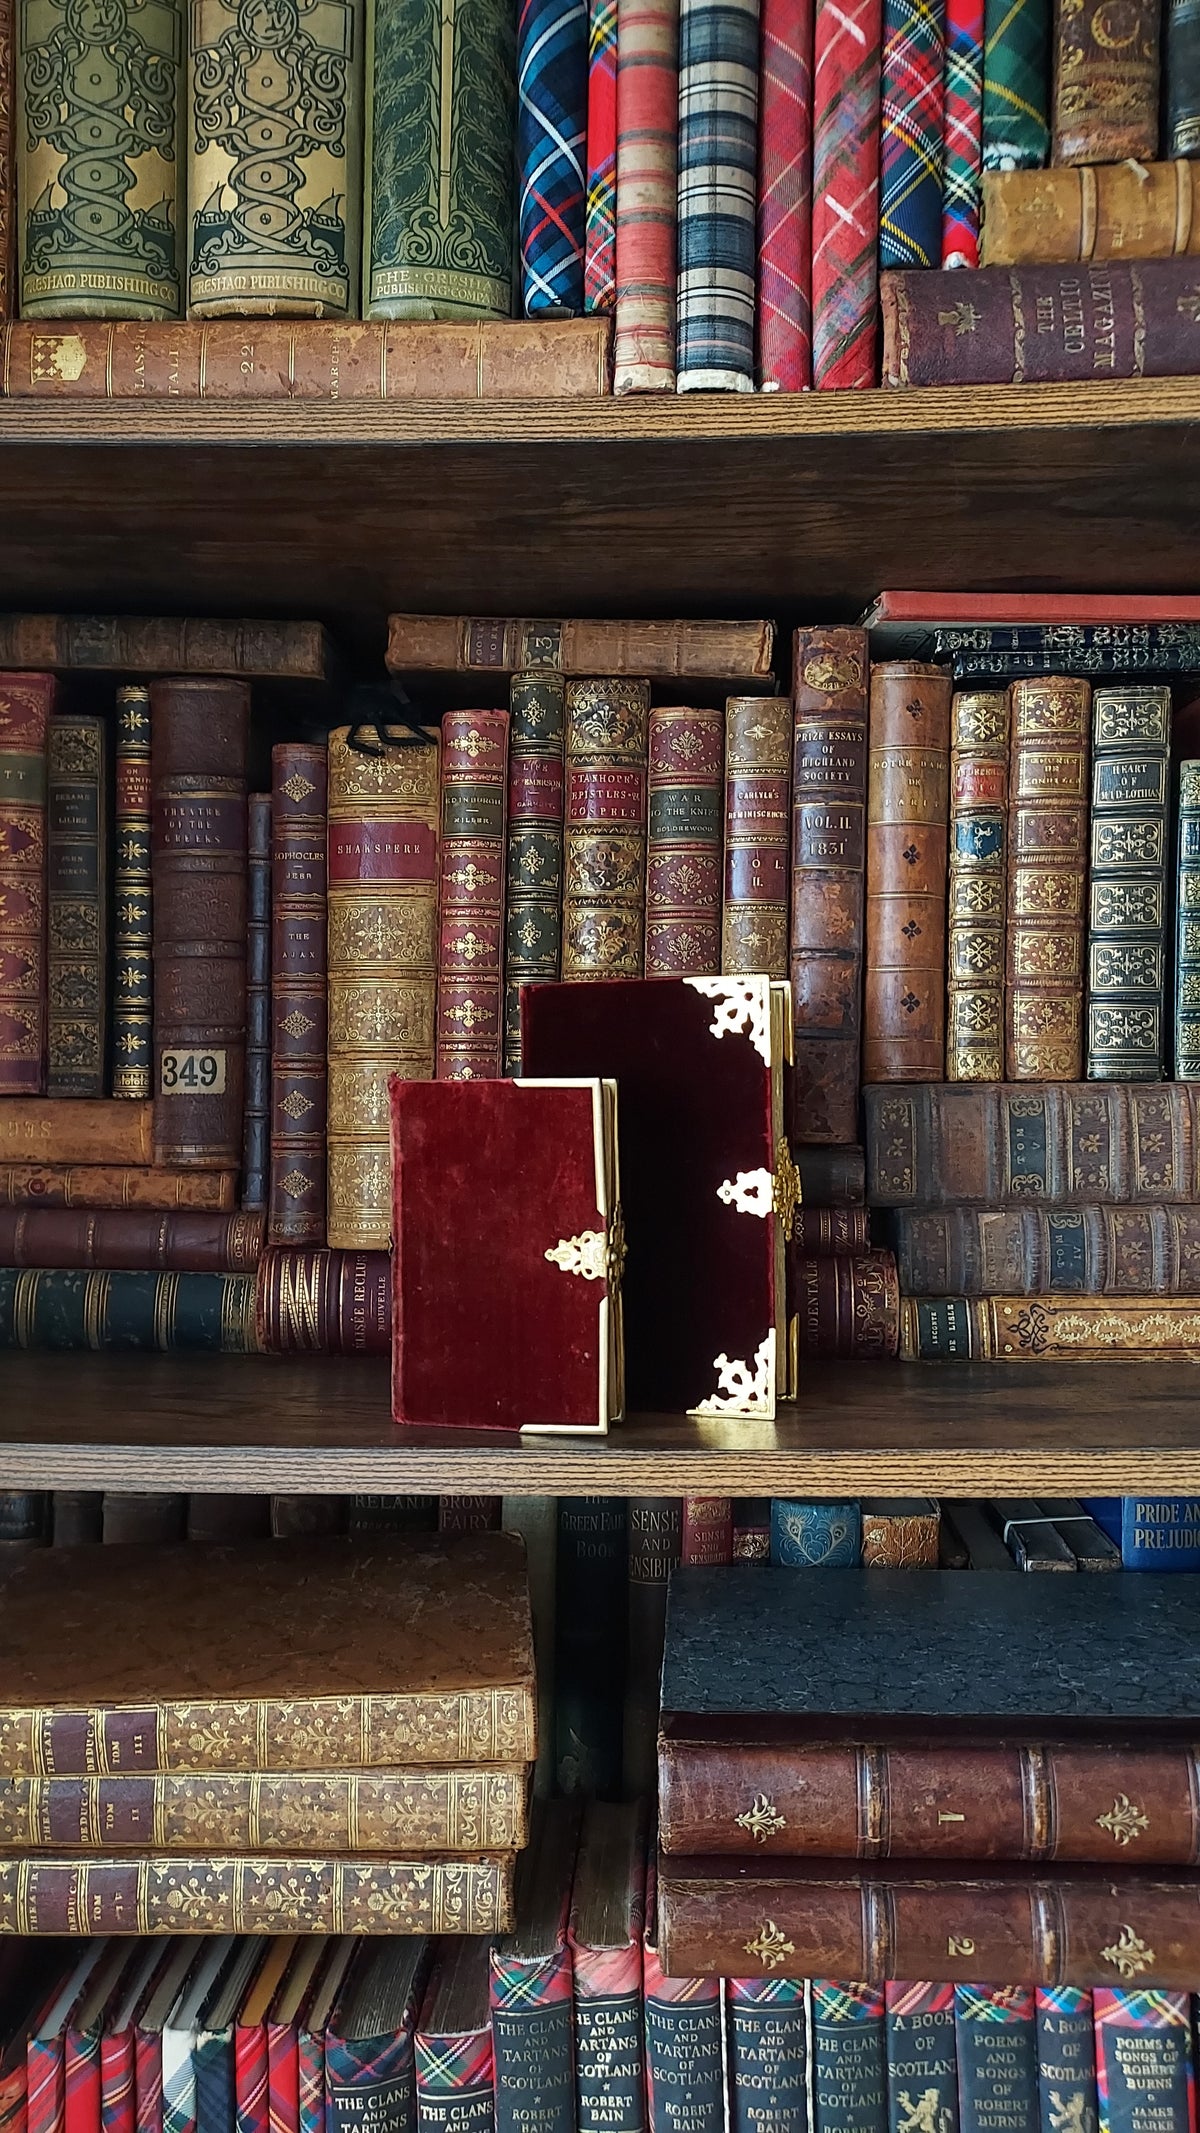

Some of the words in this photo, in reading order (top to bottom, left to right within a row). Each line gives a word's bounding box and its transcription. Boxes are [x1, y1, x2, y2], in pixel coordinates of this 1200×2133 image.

[376, 270, 410, 285] THE
[80, 273, 158, 296] PUBLISHING
[160, 286, 176, 301] CO
[251, 274, 327, 292] PUBLISHING
[328, 282, 345, 300] CO
[1037, 296, 1054, 334] THE
[1060, 278, 1085, 354] CELTIC
[240, 345, 254, 375] 22
[796, 731, 824, 743] PRIZE
[829, 731, 863, 742] ESSAYS
[821, 745, 835, 755] OF
[802, 759, 855, 768] HIGHLAND
[1112, 764, 1148, 775] HEART
[804, 770, 850, 781] SOCIETY
[1121, 777, 1138, 786] OF
[668, 793, 702, 802] WAR
[571, 806, 636, 817] GOSPELS
[667, 808, 685, 816] THE
[690, 807, 720, 817] KNIFE
[164, 834, 221, 844] GREEKS
[337, 843, 421, 854] SHAKSPERE
[809, 843, 845, 856] 1831
[274, 852, 324, 862] SOPHOCLES
[282, 951, 316, 959] AJAX
[162, 1055, 218, 1088] 349
[354, 1255, 367, 1302] RECLUS
[377, 1275, 386, 1332] NOUVELLE
[947, 1304, 955, 1331] LISLE
[930, 1311, 938, 1344] LECONTE
[949, 1339, 956, 1352] DE
[1135, 1503, 1180, 1523] PRIDE
[442, 1511, 493, 1530] FAIRY
[631, 1507, 679, 1534] SENSE
[641, 1537, 671, 1551] AND
[112, 1740, 121, 1764] TOM
[105, 1803, 114, 1830] TOM
[93, 1894, 102, 1921] TOM
[948, 1936, 975, 1957] 2
[577, 2012, 591, 2026] HE
[594, 2007, 639, 2026] CLANS
[649, 2011, 675, 2031] THE
[678, 2015, 720, 2032] CLANS
[892, 2015, 906, 2031] A
[498, 2021, 526, 2036] THE
[590, 2026, 616, 2037] AND
[733, 2017, 762, 2032] THE
[1043, 2018, 1055, 2034] A
[524, 2036, 549, 2047] AND
[577, 2035, 638, 2052] ARTANS
[673, 2033, 699, 2043] AND
[758, 2036, 785, 2046] AND
[915, 2036, 936, 2051] OF
[974, 2035, 1027, 2048] POEMS
[1115, 2037, 1163, 2051] POEMS
[1165, 2038, 1176, 2050] &
[502, 2044, 569, 2063] TARTANS
[653, 2040, 720, 2059] TARTANS
[737, 2045, 804, 2062] TARTANS
[1062, 2043, 1081, 2058] OF
[1114, 2049, 1157, 2063] SONGS
[1162, 2050, 1179, 2063] OF
[596, 2052, 612, 2063] OF
[836, 2054, 862, 2065] AND
[986, 2053, 1017, 2065] AND
[576, 2062, 641, 2079] COTLAND
[679, 2060, 695, 2071] OF
[764, 2064, 780, 2075] OF
[816, 2063, 882, 2081] TARTANS
[1122, 2063, 1176, 2076] ROBERT
[653, 2067, 722, 2086] SCOTLAND
[976, 2067, 1027, 2079] SONGS
[841, 2082, 857, 2093] OF
[992, 2084, 1013, 2096] OF
[1126, 2077, 1173, 2090] BURNS
[335, 2097, 364, 2111] THE
[367, 2085, 411, 2108] CLANS
[581, 2095, 633, 2107] ROBERT
[974, 2098, 1029, 2111] ROBERT
[362, 2109, 387, 2122] AND
[420, 2104, 447, 2121] THE
[450, 2100, 494, 2120] CLANS
[512, 2106, 562, 2121] ROBERT
[590, 2109, 624, 2121] BAIN
[665, 2101, 714, 2117] ROBERT
[747, 2106, 799, 2121] ROBERT
[1131, 2106, 1174, 2119] JAMES
[445, 2122, 470, 2133] AND
[673, 2118, 706, 2132] BAIN
[756, 2122, 790, 2133] BAIN
[977, 2114, 1027, 2128] BURNS
